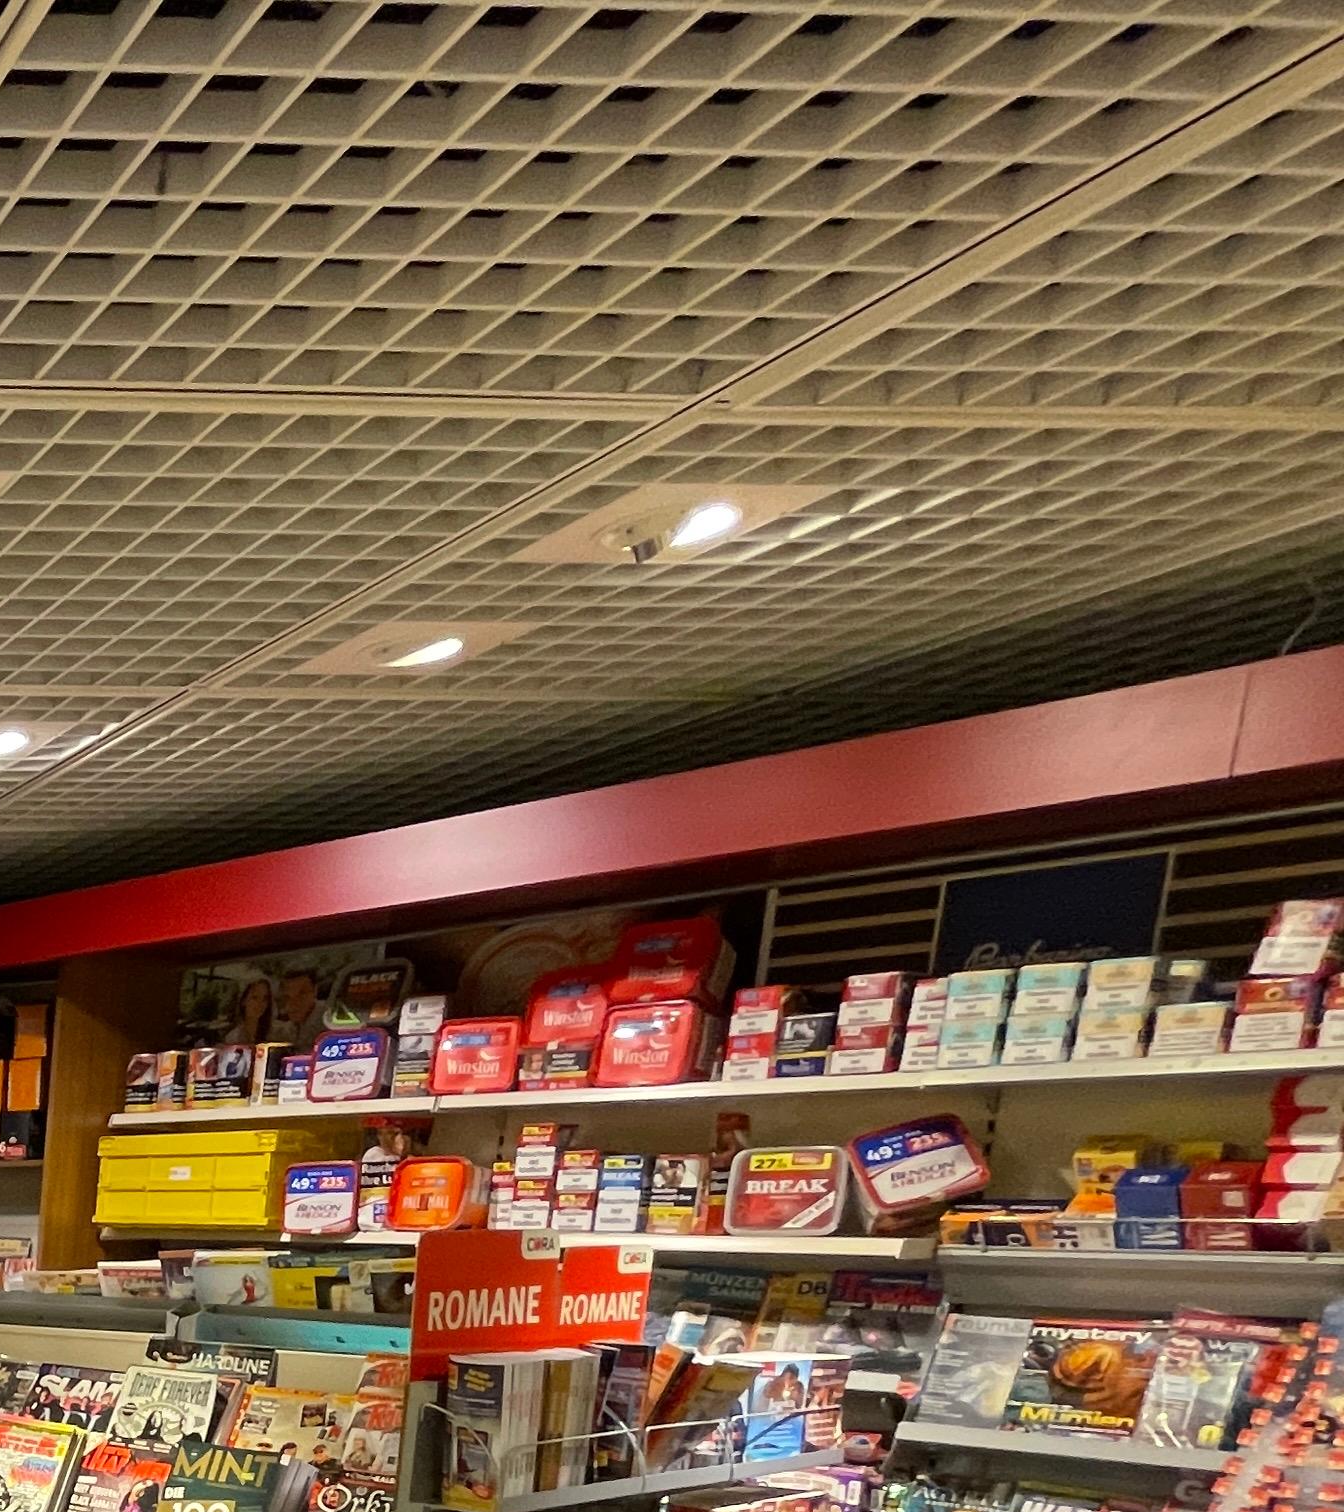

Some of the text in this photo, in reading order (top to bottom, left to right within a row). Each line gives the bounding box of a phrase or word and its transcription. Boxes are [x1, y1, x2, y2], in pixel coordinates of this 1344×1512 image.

[543, 1009, 593, 1028] Winston
[612, 1047, 669, 1066] Winston
[446, 1058, 499, 1078] Winston
[745, 1178, 829, 1195] BREAK
[426, 1284, 541, 1332] ROMANE
[559, 1290, 644, 1327] ROMANE
[1031, 1325, 1153, 1344] mystery
[192, 1352, 271, 1375] HARDLINE
[38, 1373, 123, 1403] SLAM
[1019, 1404, 1135, 1428] Mumien
[173, 1447, 280, 1488] MINT
[164, 1486, 186, 1500] DIE
